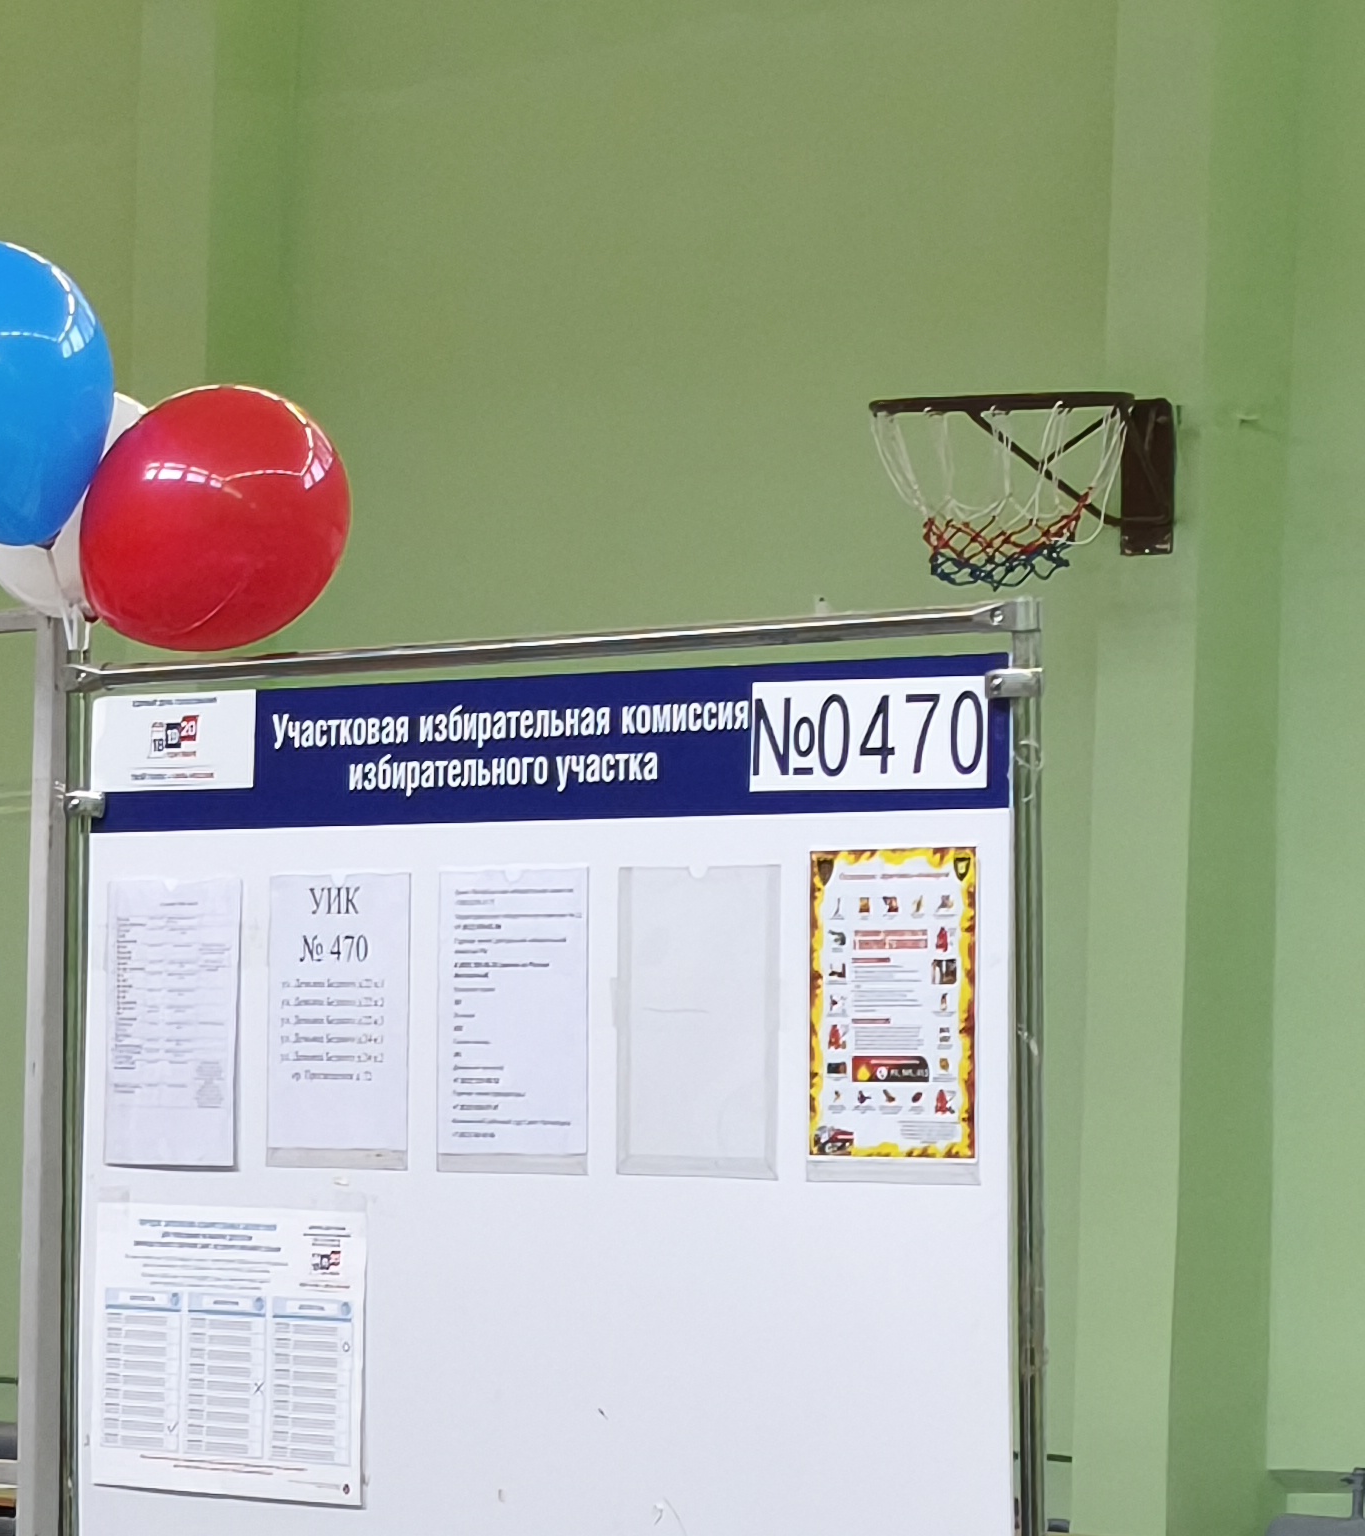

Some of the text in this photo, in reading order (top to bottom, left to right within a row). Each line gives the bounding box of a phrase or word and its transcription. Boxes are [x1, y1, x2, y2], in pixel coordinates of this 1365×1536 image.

[181, 721, 196, 736] 20
[272, 700, 750, 750] Участковая избирательная комиссия
[752, 690, 984, 777] №0470
[348, 752, 659, 797] избирательного участка
[309, 886, 360, 915] УИК
[299, 935, 369, 962] № 470
